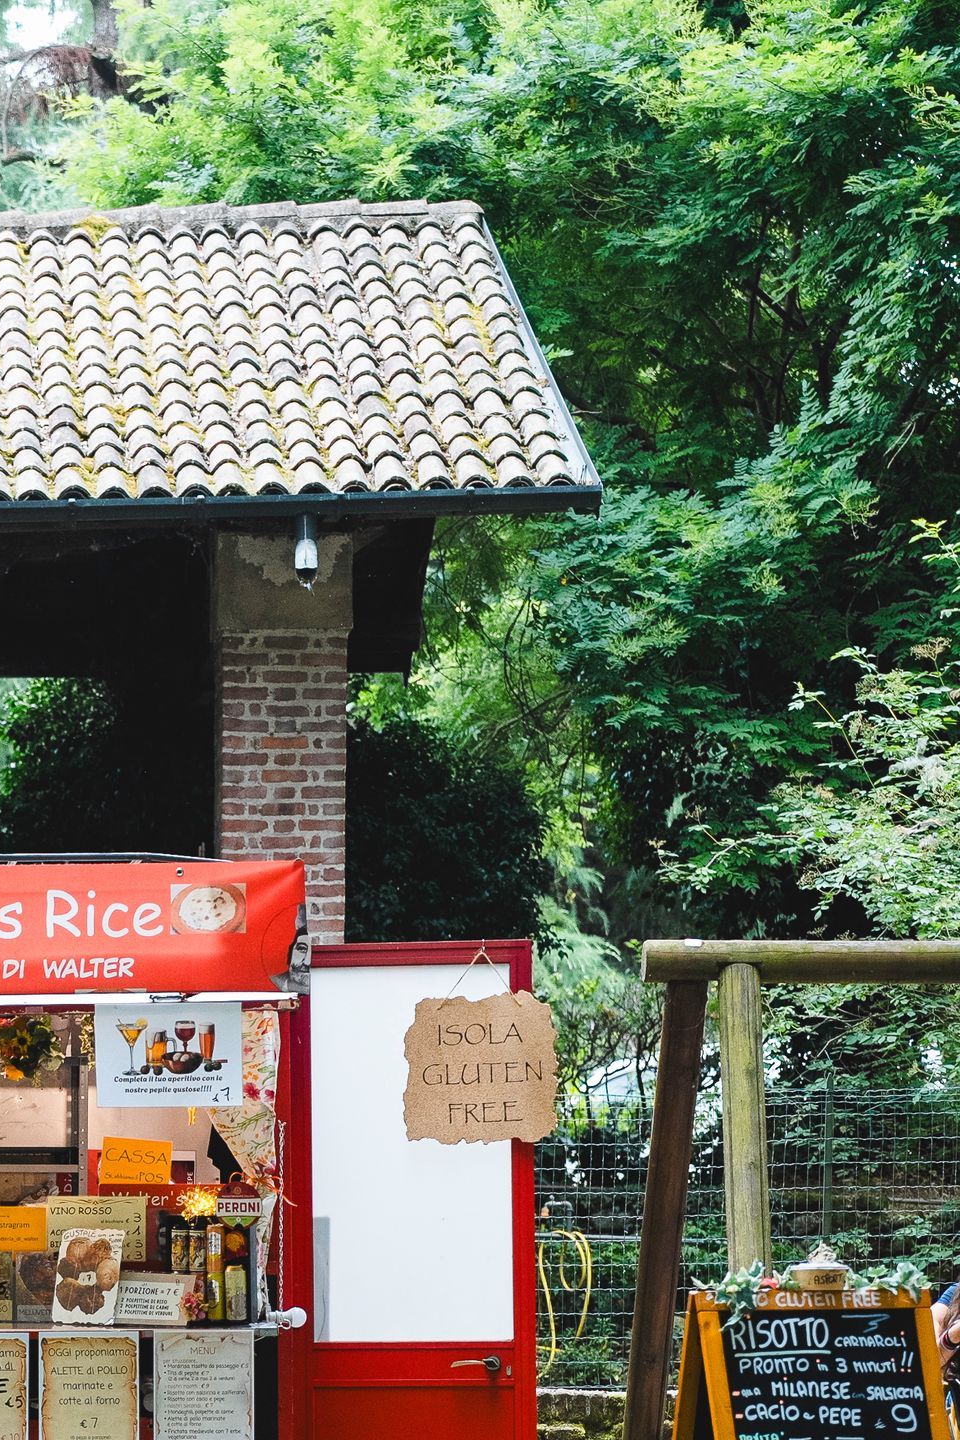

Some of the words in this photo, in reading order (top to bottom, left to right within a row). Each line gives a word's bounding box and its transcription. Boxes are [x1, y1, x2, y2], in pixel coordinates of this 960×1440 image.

[46, 889, 164, 938] Rice
[2, 959, 26, 979] DI
[43, 957, 135, 979] WALTER
[437, 1022, 523, 1046] ISOLA
[422, 1061, 543, 1086] GLUTEN
[448, 1100, 523, 1124] FREE
[105, 1147, 168, 1166] CASSA
[139, 1171, 164, 1184] POS
[50, 1206, 76, 1216] VINO
[79, 1206, 113, 1216] ROSSO
[217, 1201, 260, 1213] PERONI
[133, 1212, 142, 1224] 3
[124, 1286, 159, 1295] PORZIONE
[166, 1288, 171, 1296] 7
[173, 1288, 180, 1297] €
[841, 1291, 882, 1308] FREE
[730, 1314, 829, 1350] RISOTTO
[48, 1347, 72, 1357] OGGI
[75, 1348, 131, 1360] proponiamo
[50, 1366, 84, 1375] ALETTE
[86, 1365, 95, 1375] di
[97, 1365, 128, 1375] POLLO
[836, 1357, 849, 1374] 3
[62, 1381, 105, 1390] marinate
[866, 1384, 924, 1401] SALSICCIA
[58, 1396, 82, 1406] cotte
[84, 1395, 93, 1405] al
[95, 1395, 121, 1405] forno
[79, 1419, 88, 1429] €
[90, 1417, 98, 1429] 7
[818, 1405, 862, 1427] PEPE
[891, 1403, 918, 1433] 9
